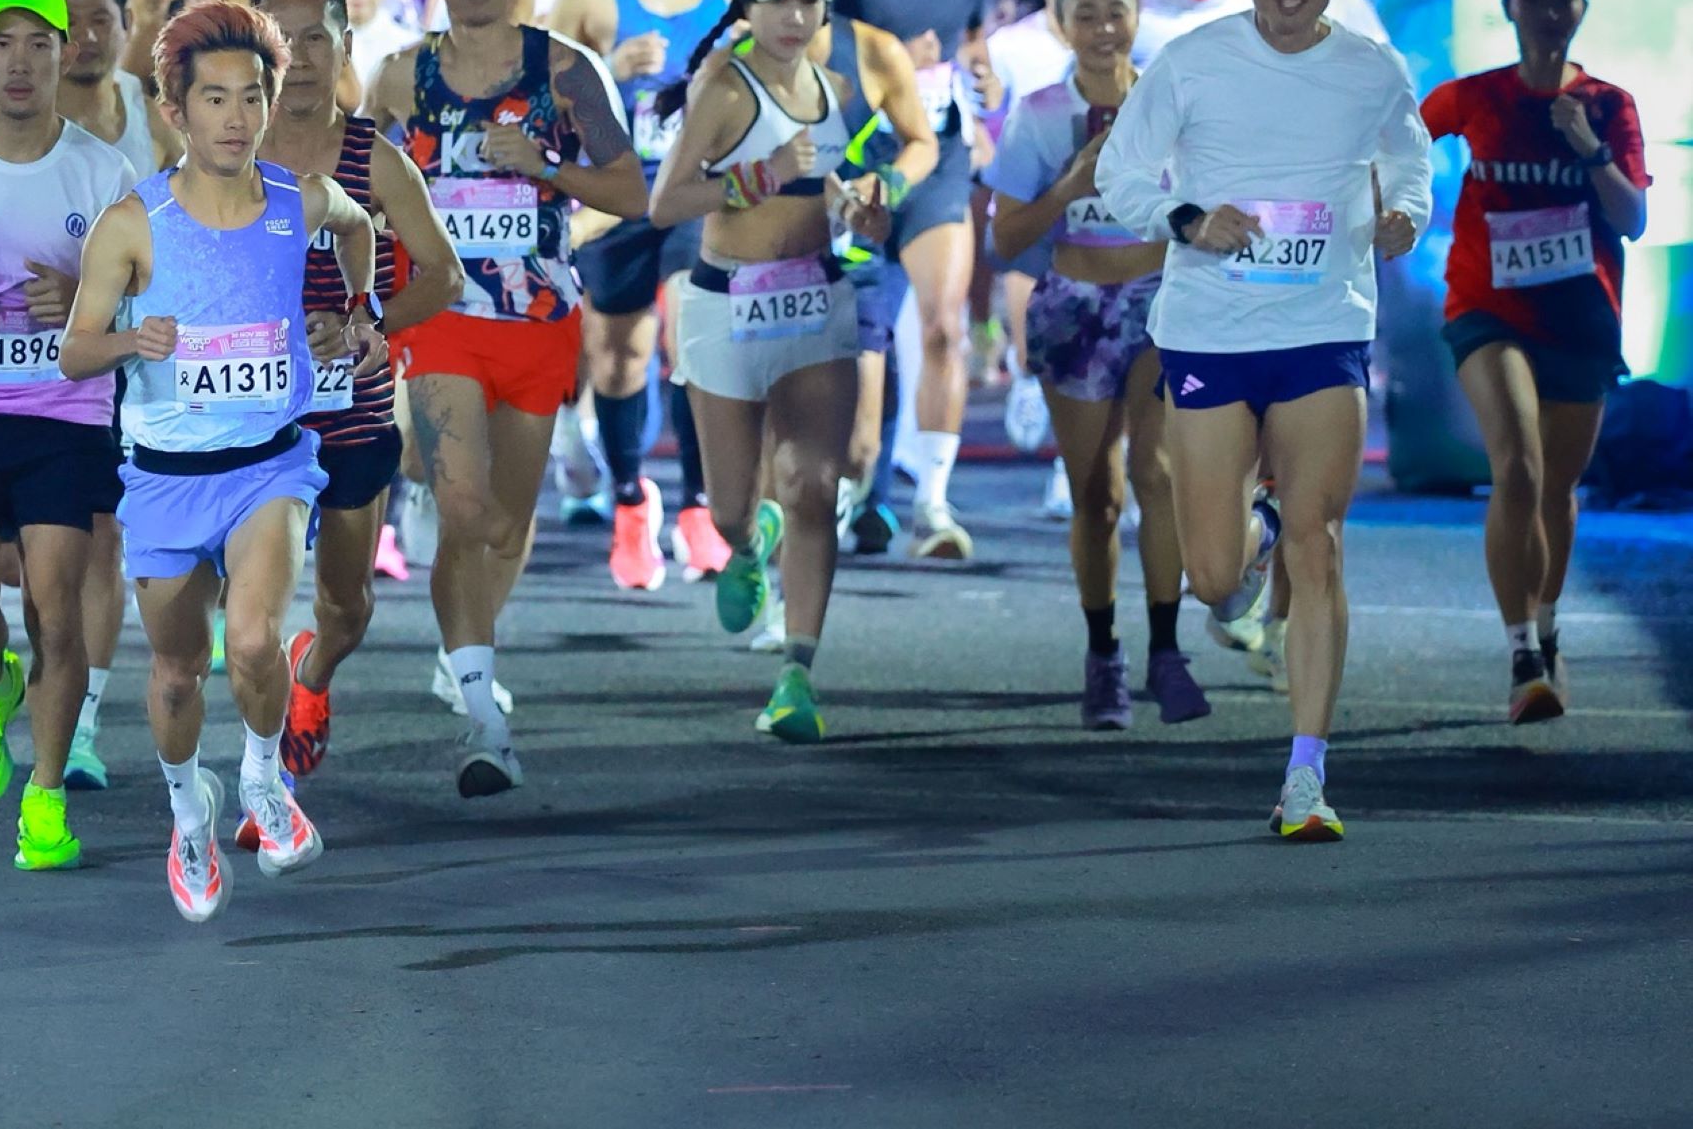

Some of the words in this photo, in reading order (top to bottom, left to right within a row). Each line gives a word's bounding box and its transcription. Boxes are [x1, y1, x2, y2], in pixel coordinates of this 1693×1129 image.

[446, 213, 531, 240] A1498
[1235, 238, 1326, 265] A2307
[1507, 235, 1584, 269] A1511
[748, 289, 829, 322] A1823
[273, 340, 287, 352] KM
[274, 327, 286, 340] 10
[193, 359, 287, 394] A1315
